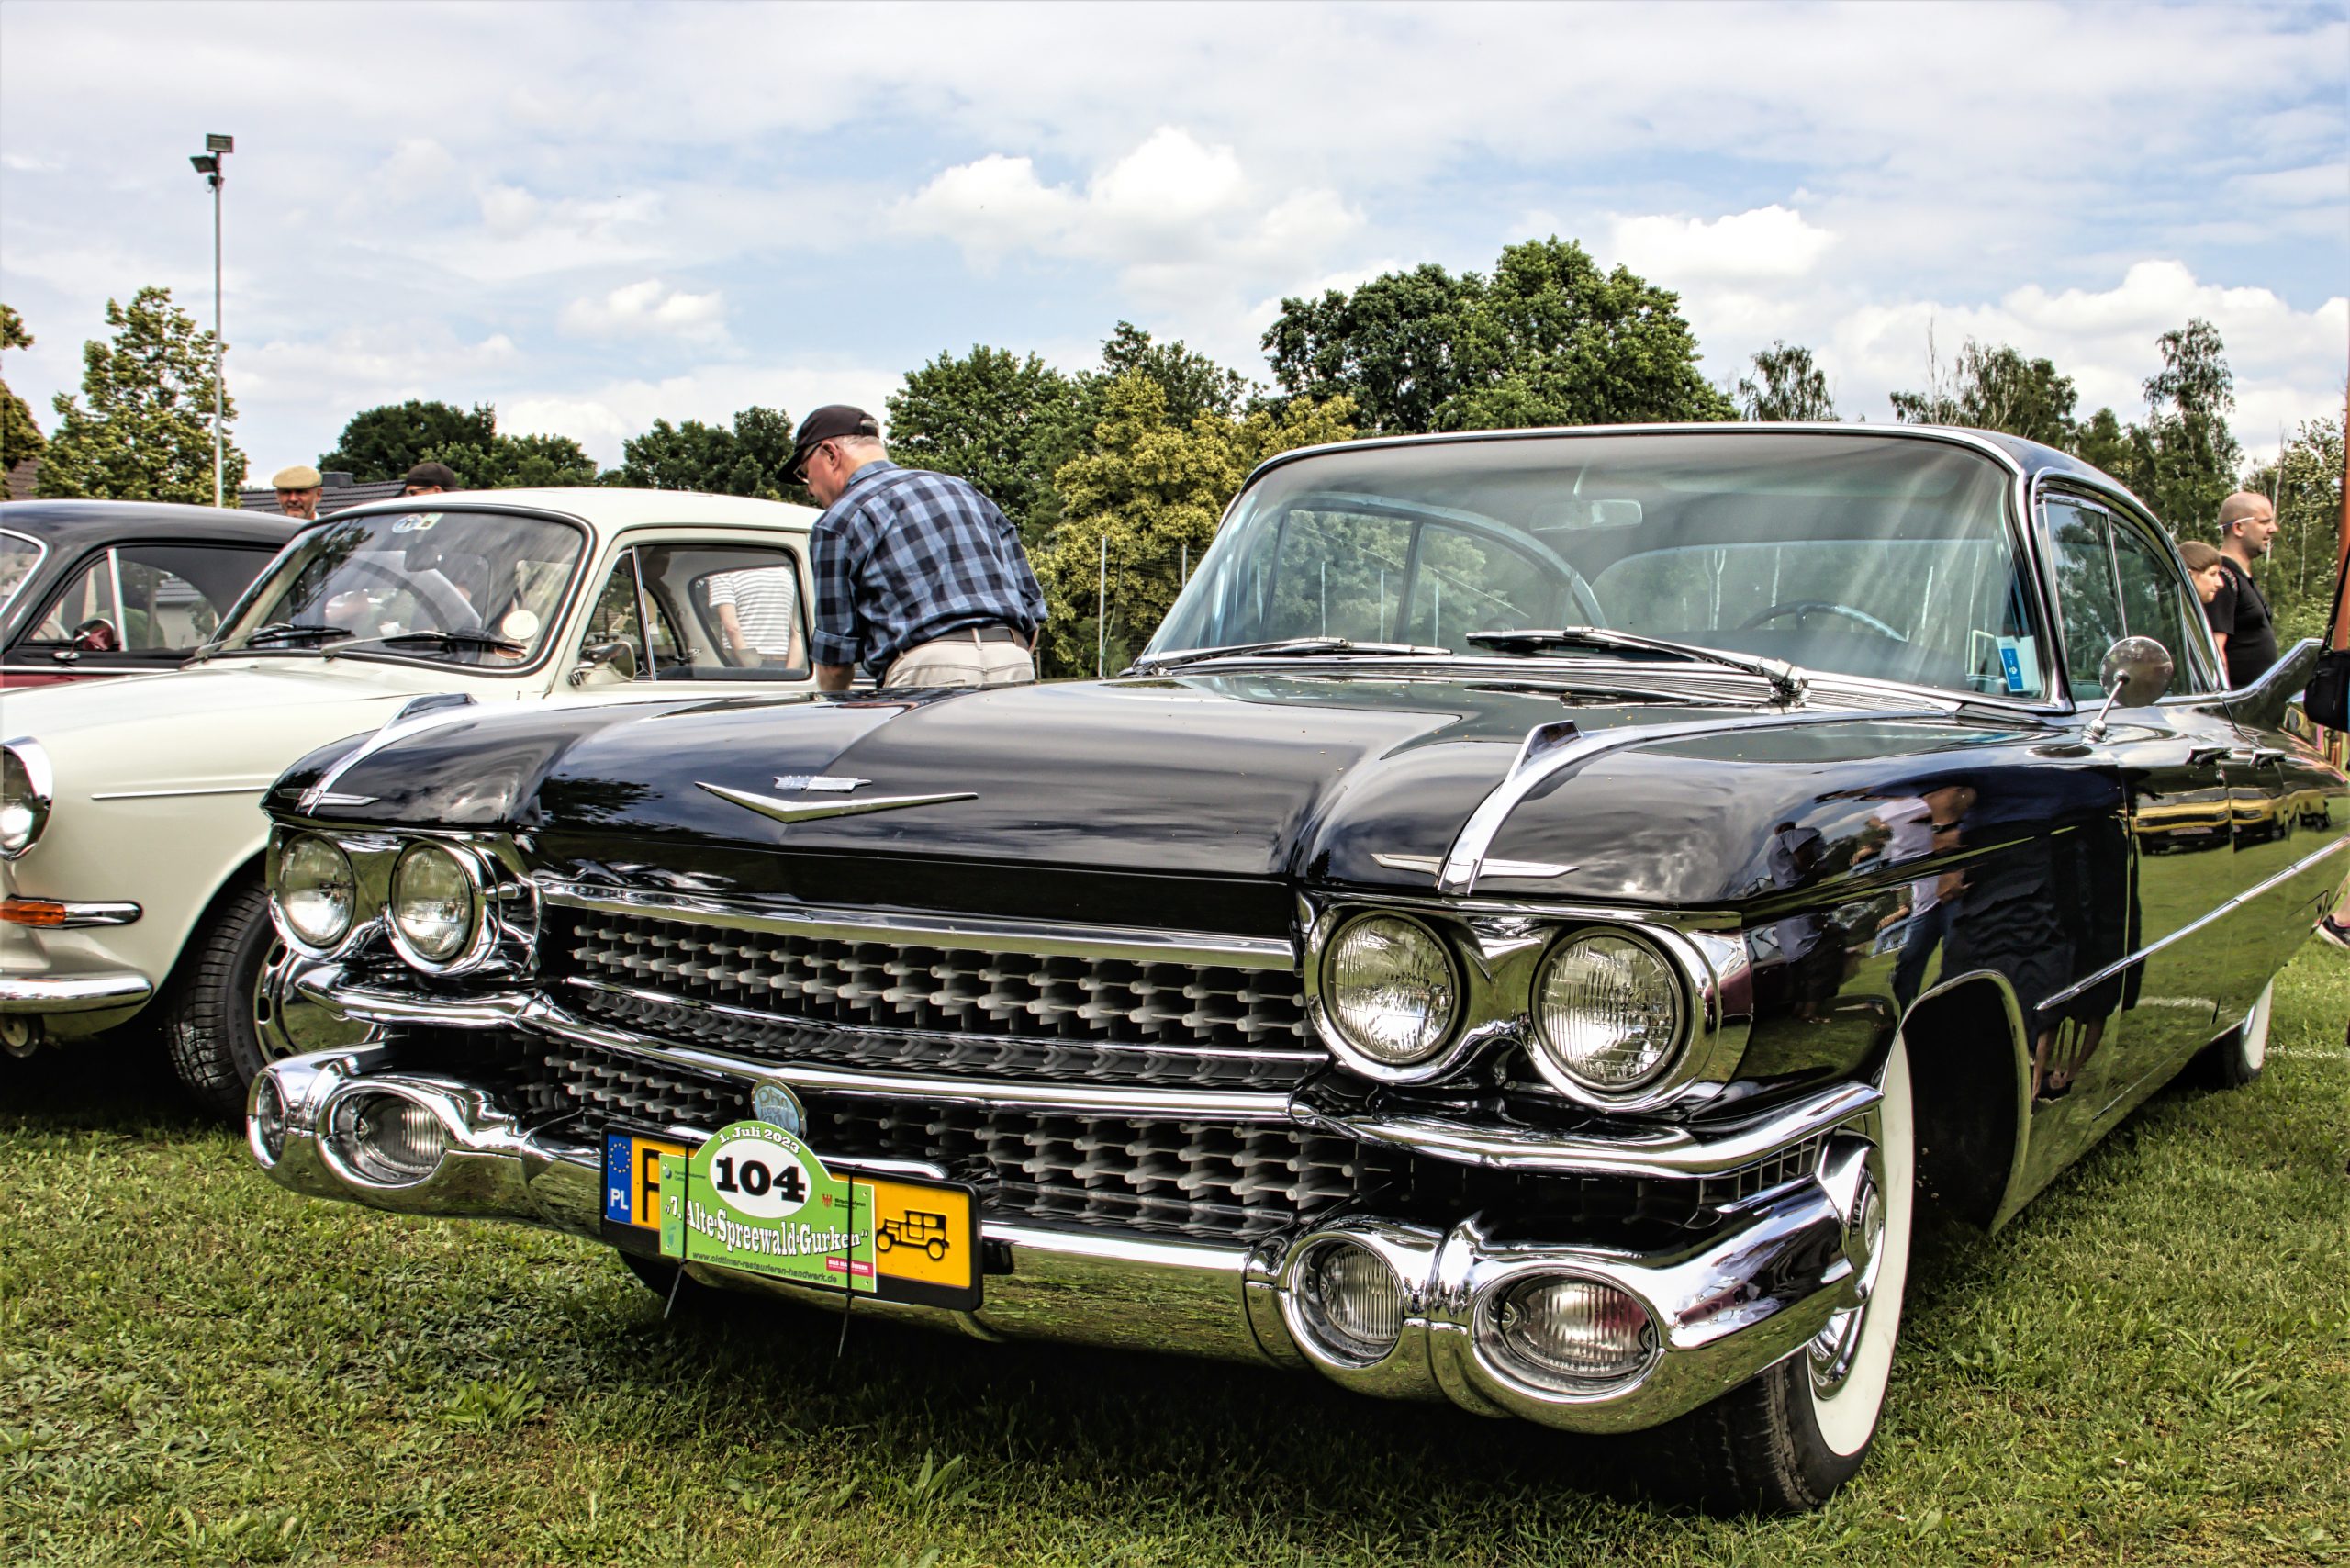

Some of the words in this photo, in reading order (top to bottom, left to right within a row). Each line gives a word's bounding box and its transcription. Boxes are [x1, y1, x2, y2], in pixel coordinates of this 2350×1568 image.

[719, 1133, 730, 1144] 1.
[732, 1126, 762, 1138] Juli
[764, 1128, 800, 1154] 2023
[716, 1156, 806, 1204] 104
[610, 1187, 629, 1211] PL
